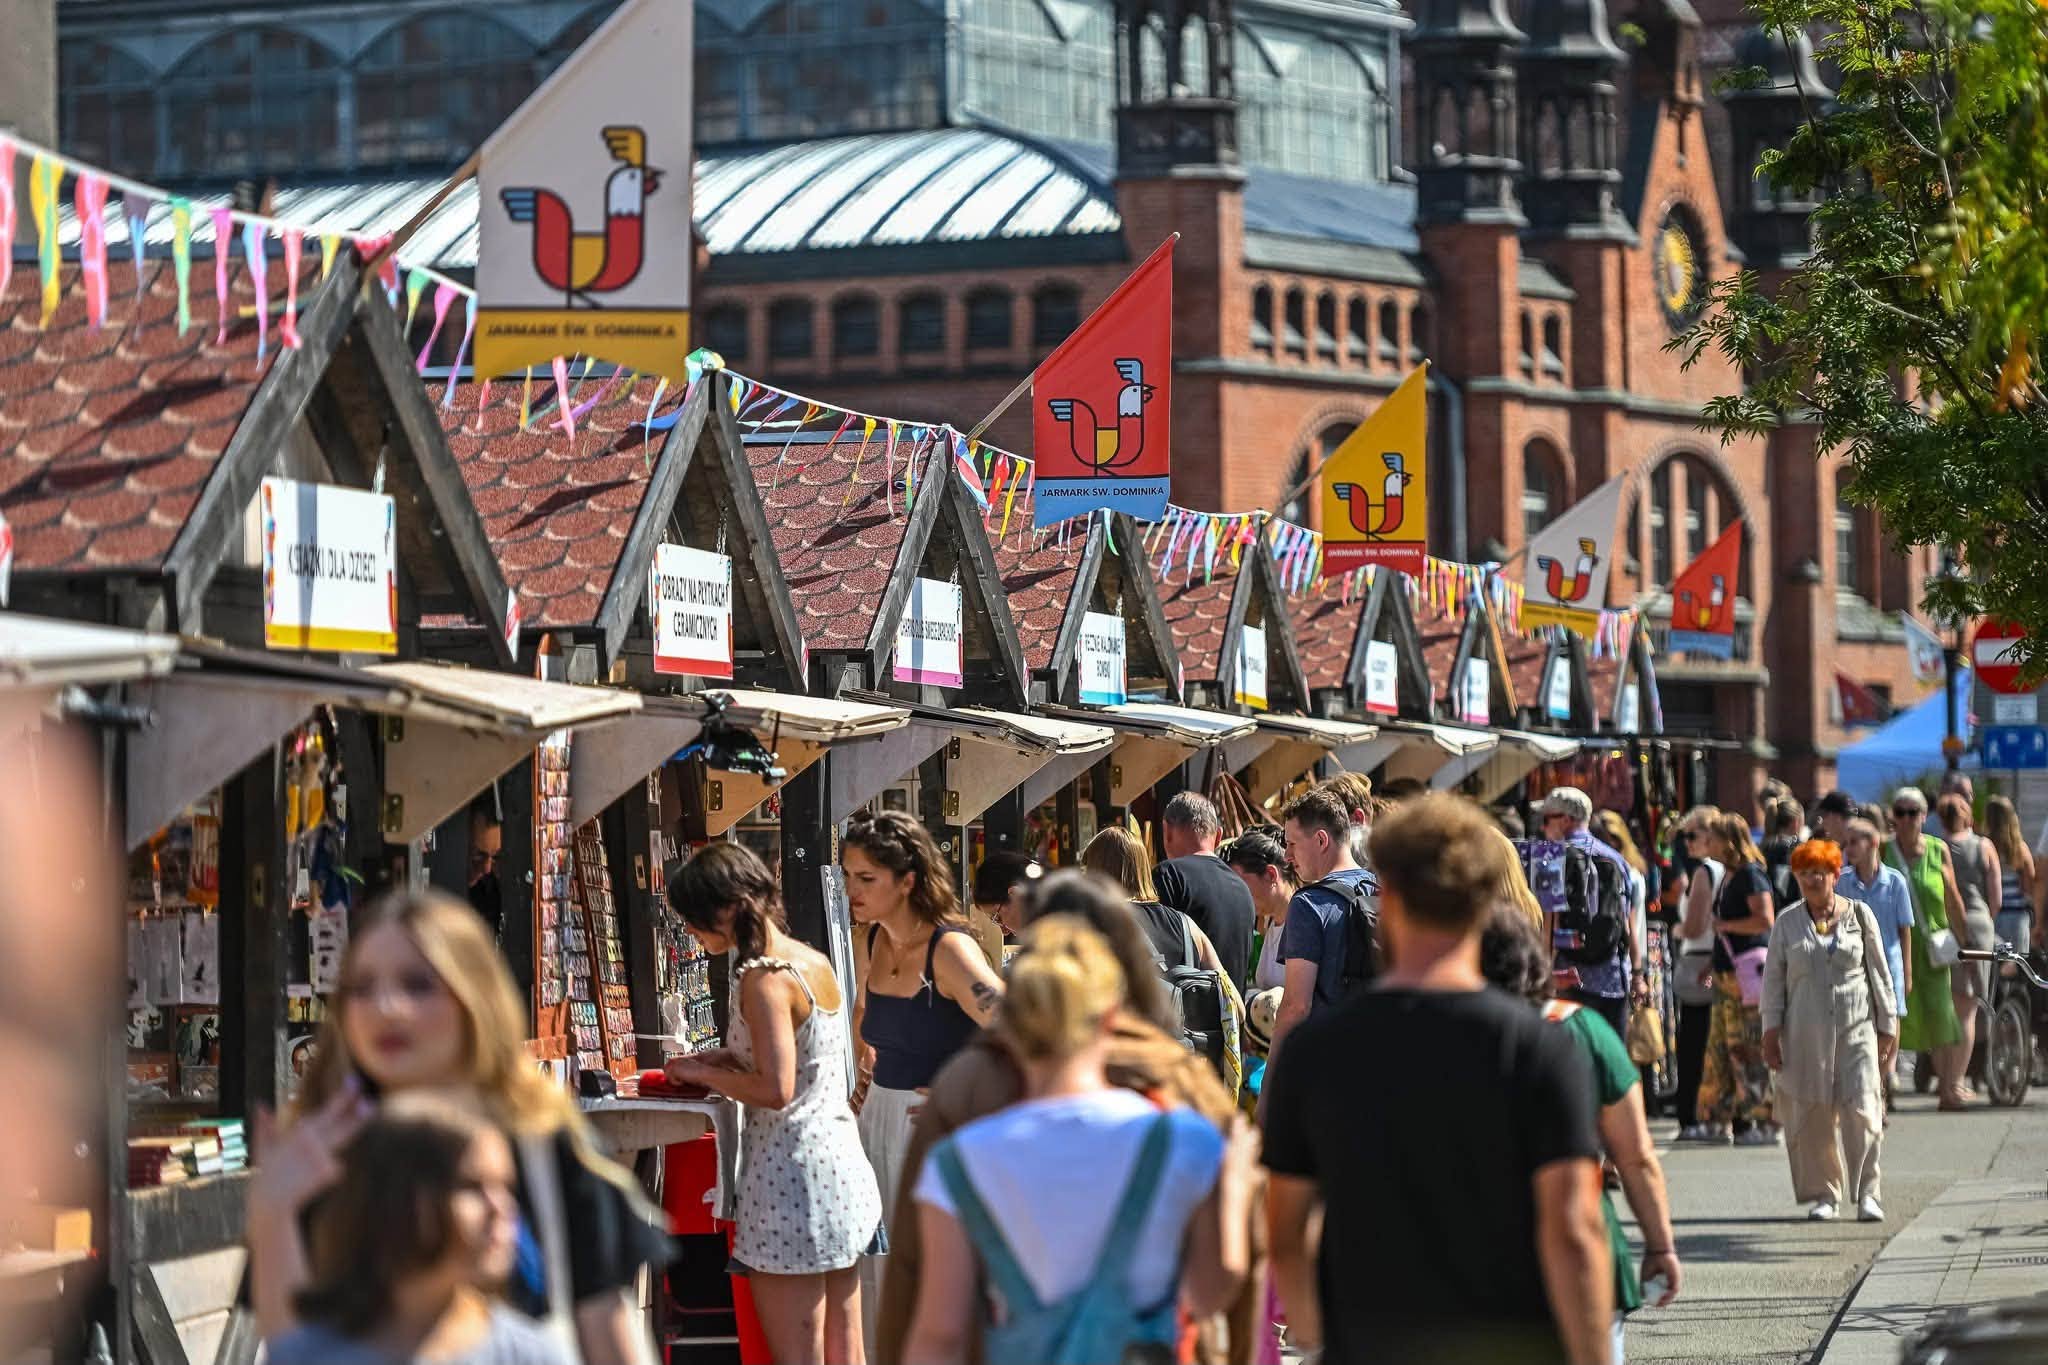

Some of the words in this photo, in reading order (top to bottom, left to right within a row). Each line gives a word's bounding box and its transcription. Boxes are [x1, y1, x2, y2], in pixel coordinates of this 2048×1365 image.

[487, 323, 556, 337] JARMARK
[594, 323, 676, 338] DOMINIKA
[1041, 488, 1089, 497] JARMARK
[1113, 487, 1165, 496] DOMINIKA
[288, 537, 324, 588] KSIĄŻKI
[327, 548, 346, 580] DLA
[350, 551, 376, 583] DZIECI
[662, 574, 687, 602] OBRAZY
[688, 579, 697, 603] NA
[673, 611, 718, 641] CERAMICZNYCH
